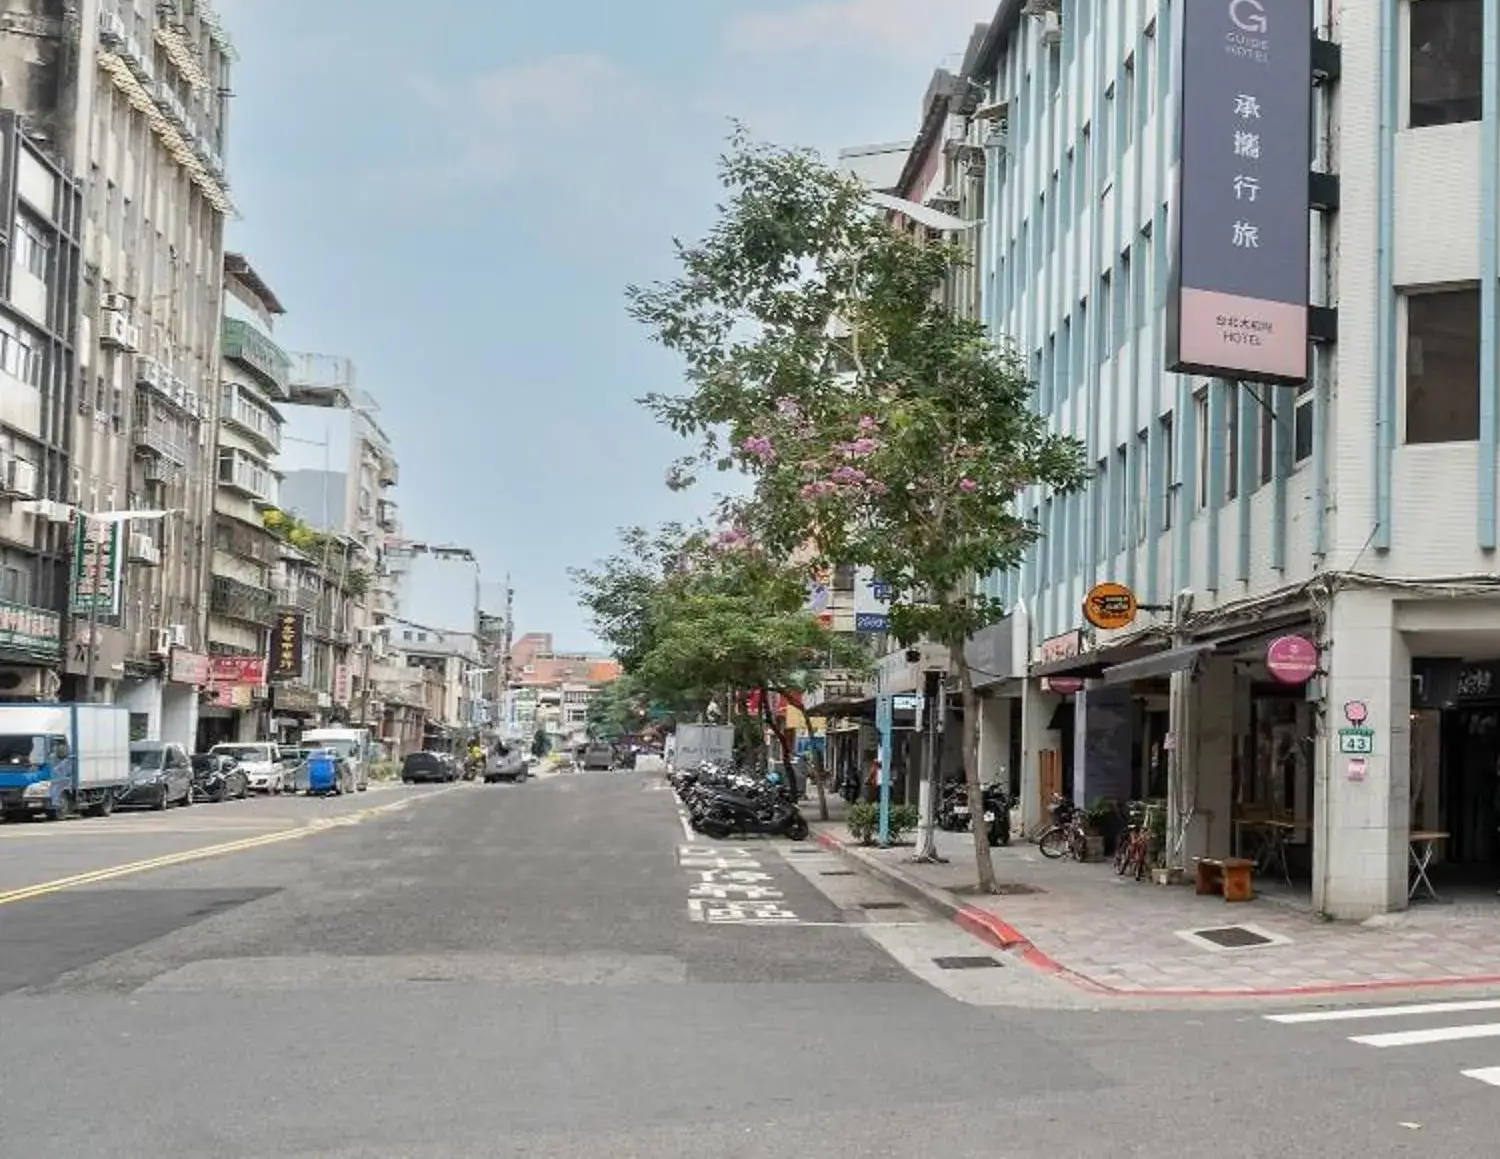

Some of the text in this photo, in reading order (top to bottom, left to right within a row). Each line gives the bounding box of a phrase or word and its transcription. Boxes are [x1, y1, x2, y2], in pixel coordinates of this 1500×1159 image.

[1226, 32, 1270, 50] GUIDE
[1225, 44, 1270, 63] HOTEL
[1223, 331, 1262, 346] HOTEL
[1347, 738, 1367, 750] 43
